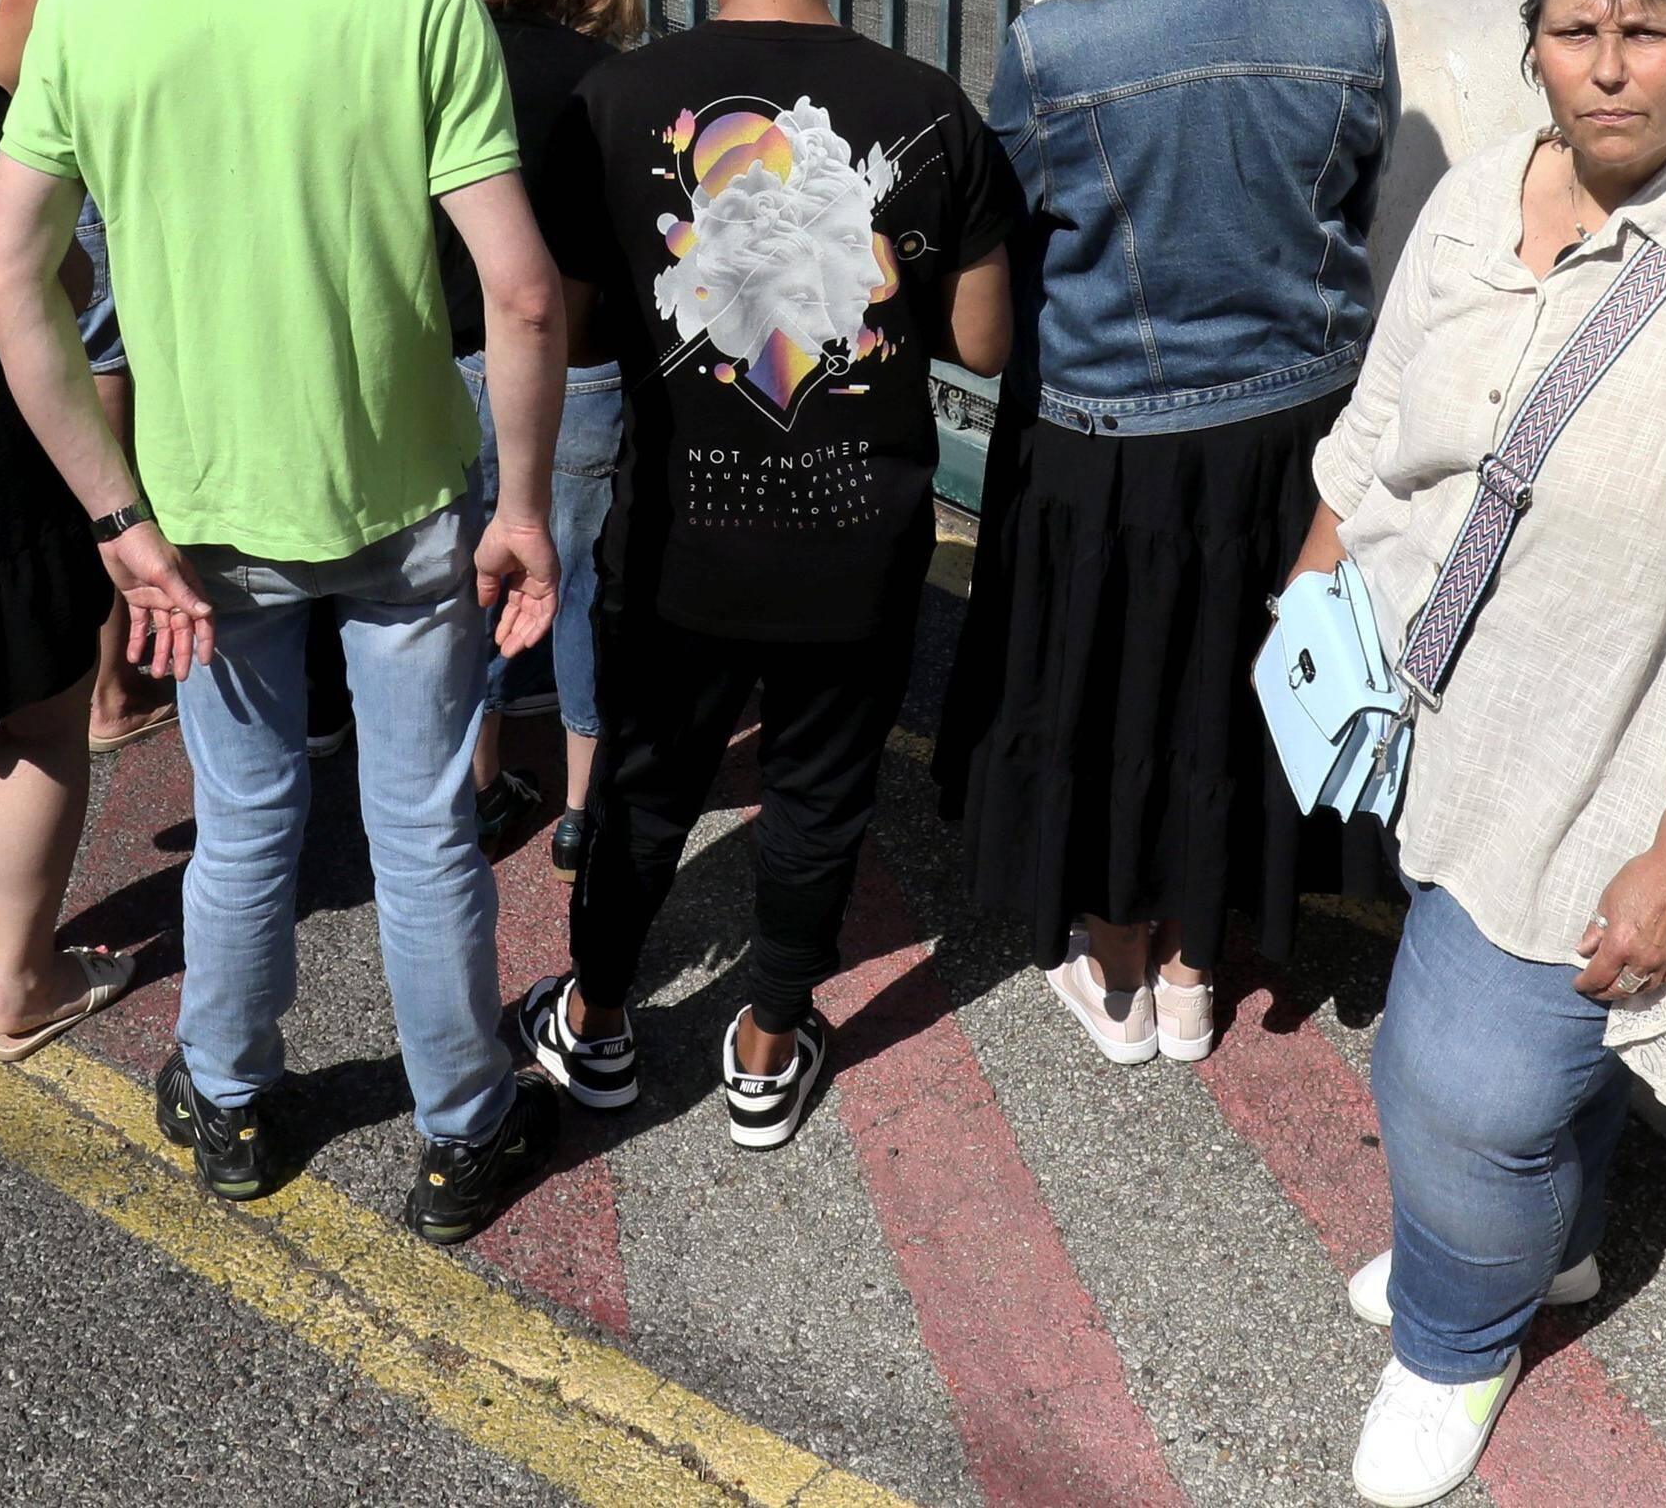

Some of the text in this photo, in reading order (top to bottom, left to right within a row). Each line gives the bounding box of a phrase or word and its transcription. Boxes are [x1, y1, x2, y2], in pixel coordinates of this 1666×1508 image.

[689, 441, 870, 470] NOT ANOTHER
[689, 459, 868, 485] LAUNCH PARTY
[689, 473, 873, 499] 21 TO SEASON
[791, 495, 867, 515] HOUSE
[688, 517, 754, 527] GUEST
[836, 508, 881, 529] ONLY
[602, 1042, 626, 1056] NIKE
[738, 1079, 766, 1094] NIKE
